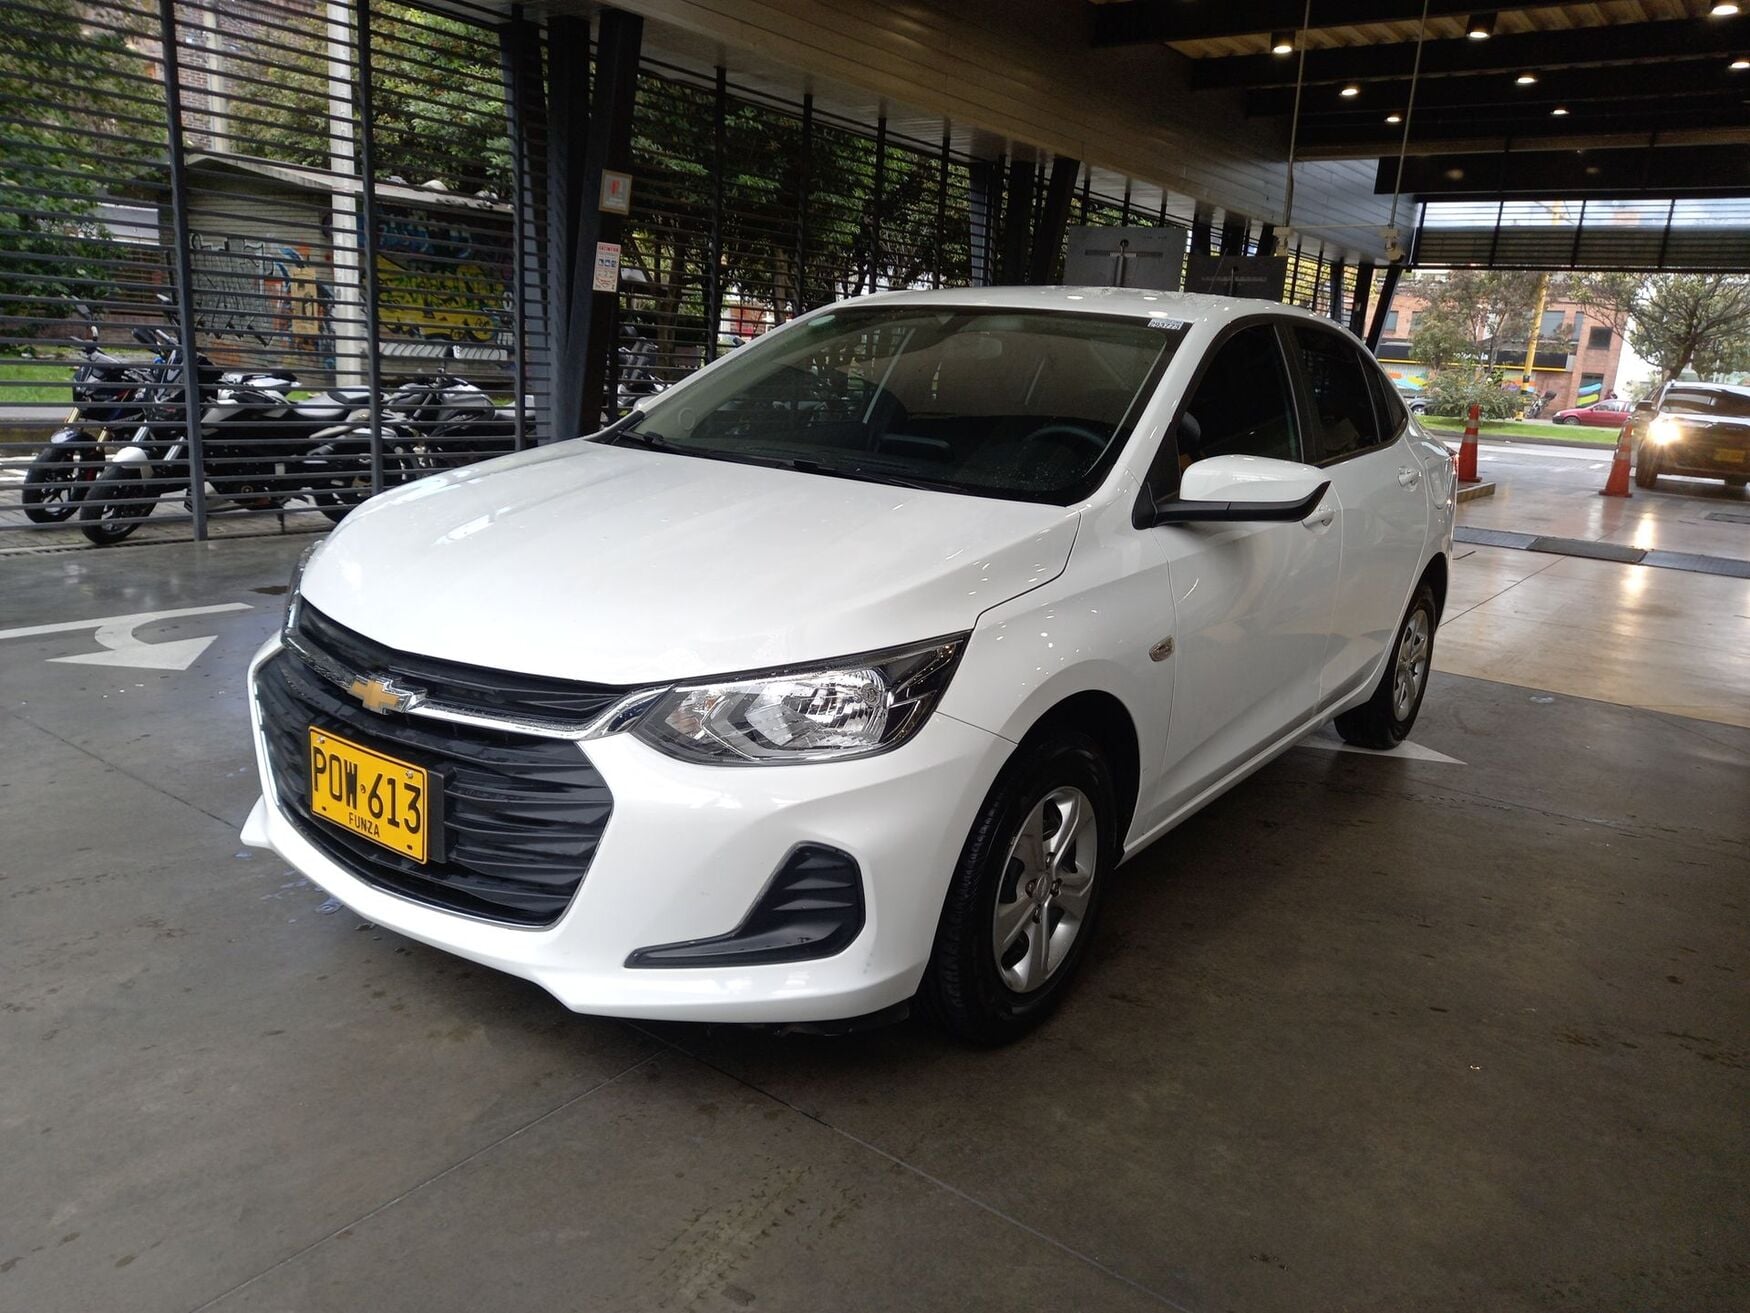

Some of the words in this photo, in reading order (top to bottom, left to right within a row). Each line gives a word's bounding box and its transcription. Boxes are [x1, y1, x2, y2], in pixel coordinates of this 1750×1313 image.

[314, 747, 358, 809] POW
[368, 773, 421, 834] 613
[349, 812, 380, 837] FUNZA
